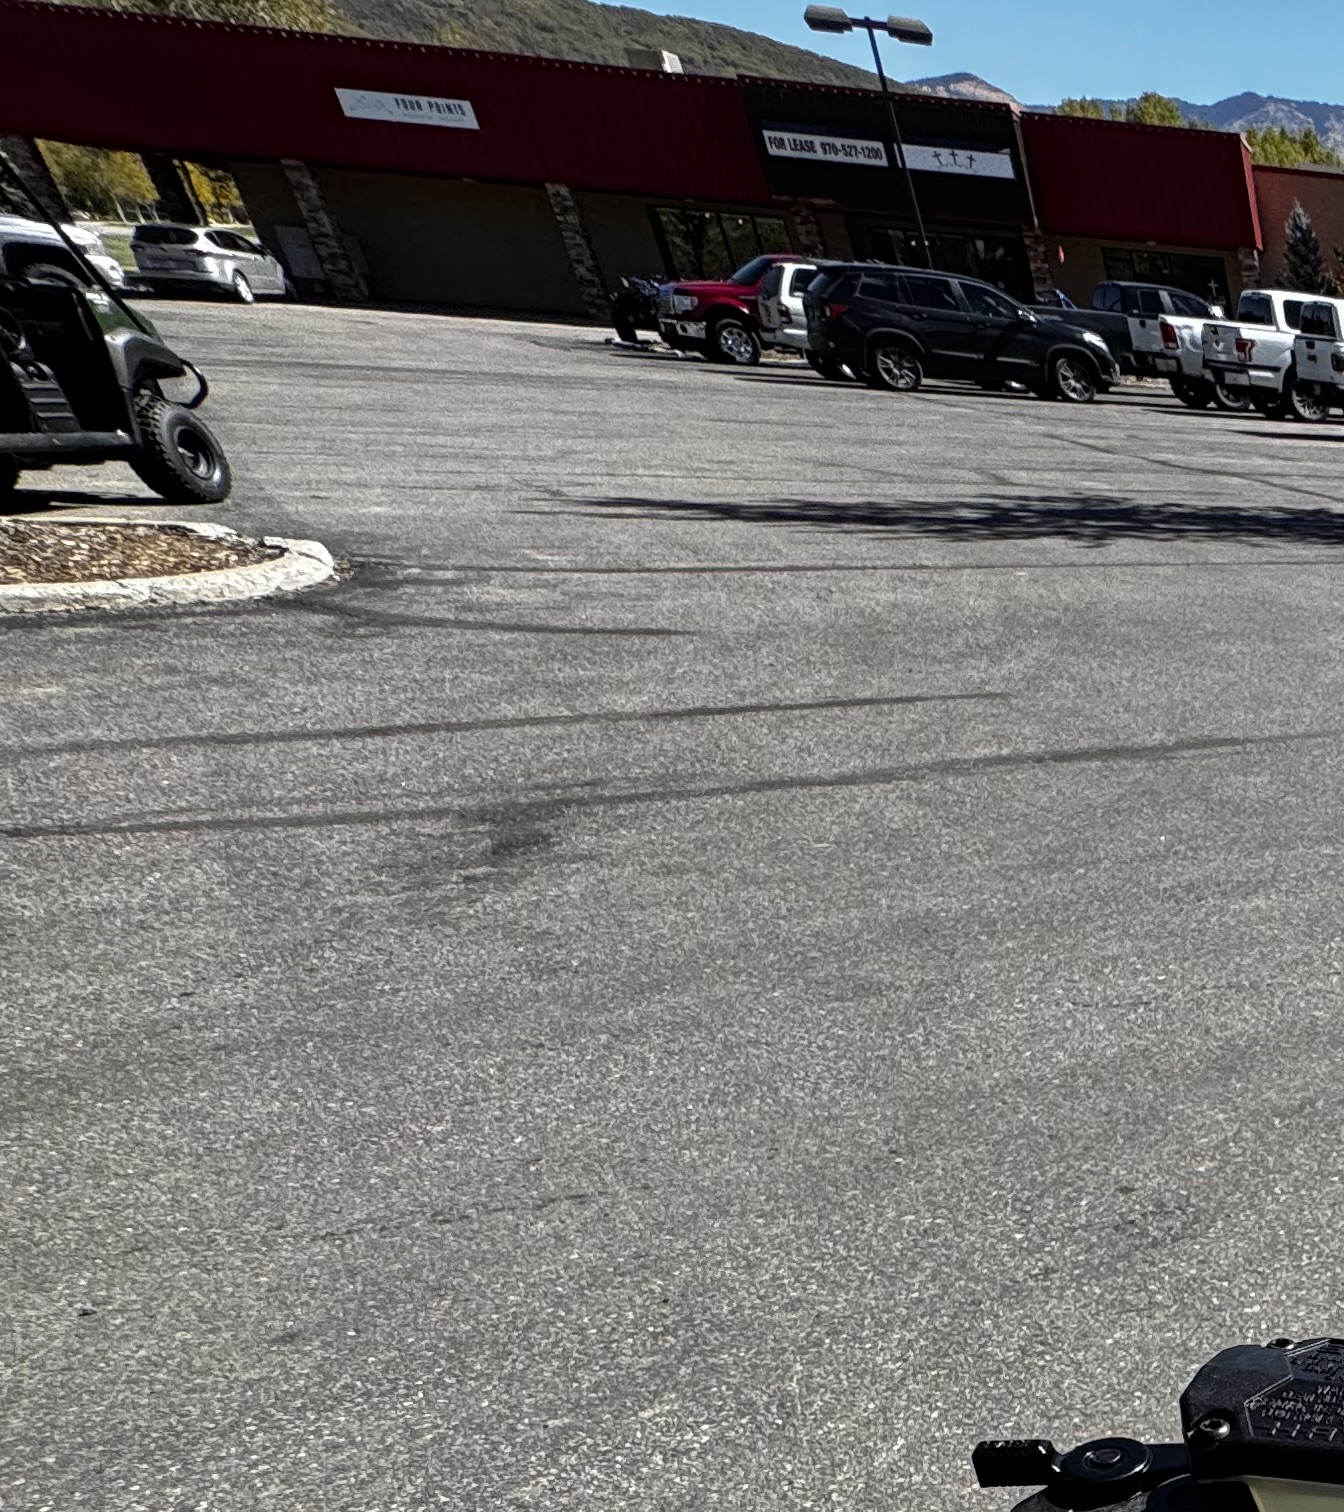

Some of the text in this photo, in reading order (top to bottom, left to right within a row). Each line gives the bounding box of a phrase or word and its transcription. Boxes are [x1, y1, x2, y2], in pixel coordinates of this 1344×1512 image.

[394, 98, 466, 116] FOUR POINTS
[767, 135, 883, 161] FOR LEASE 970-527-1200
